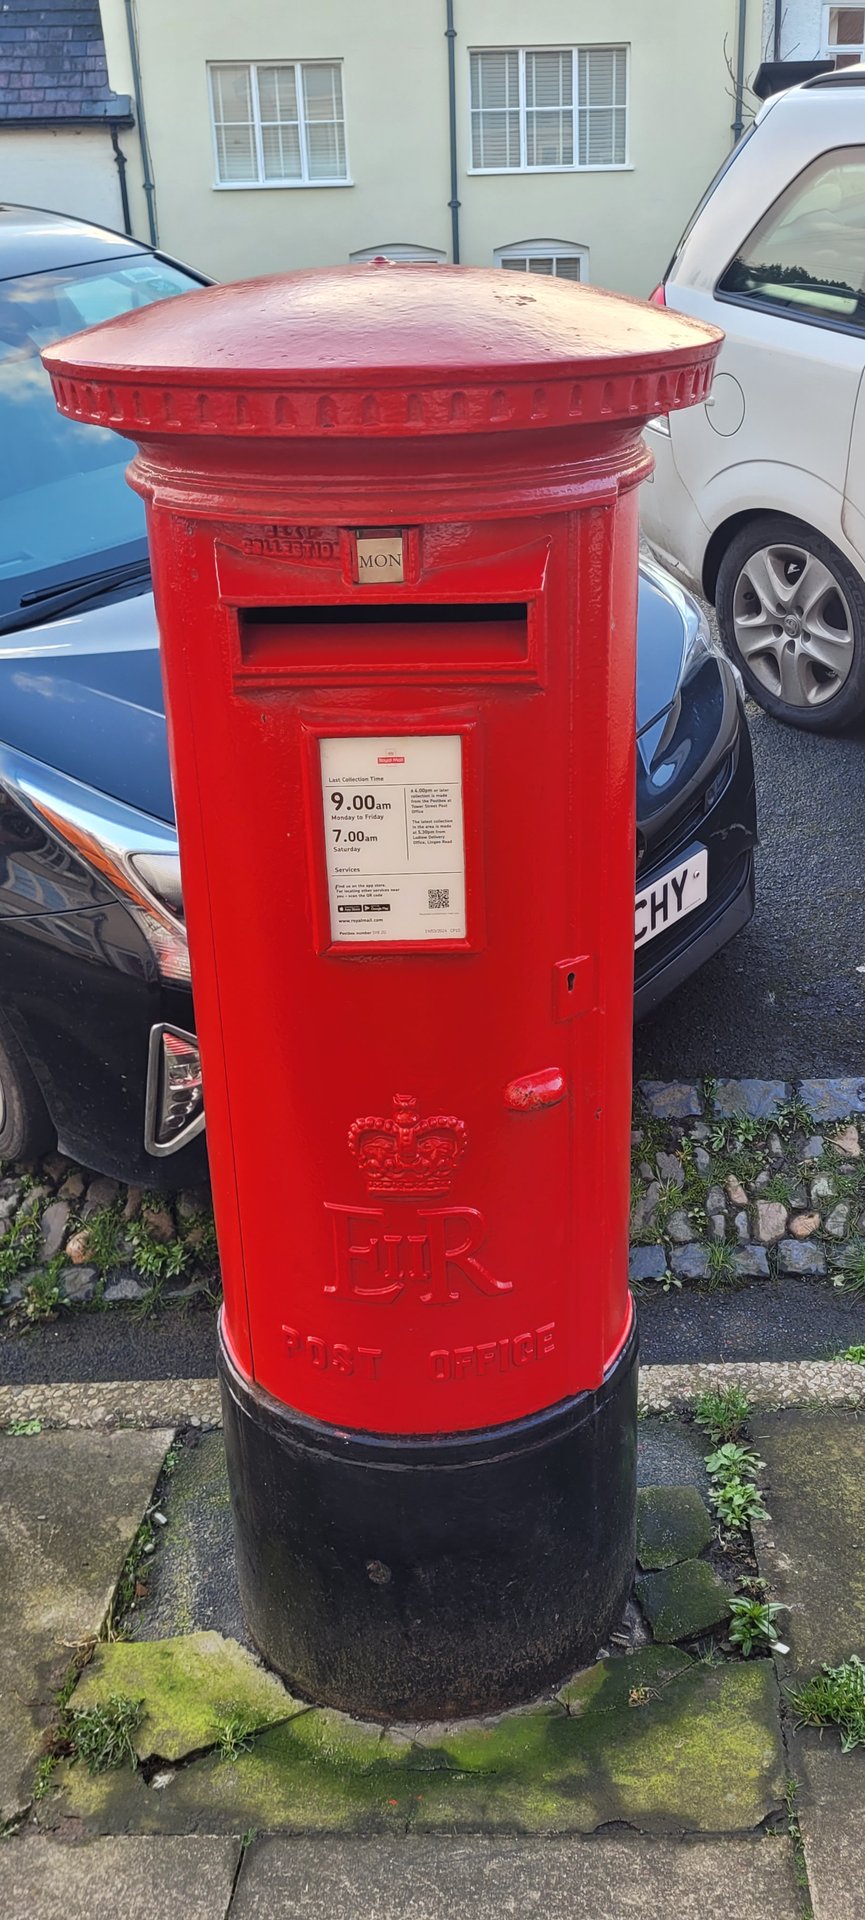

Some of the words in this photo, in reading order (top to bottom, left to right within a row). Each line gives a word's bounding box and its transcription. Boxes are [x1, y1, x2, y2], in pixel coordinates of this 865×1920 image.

[359, 554, 401, 569] MON
[331, 792, 391, 810] 9.00am
[332, 830, 378, 843] 7.00am
[635, 869, 688, 942] CHY
[282, 1324, 383, 1380] POST
[429, 1321, 556, 1382] OFFICE
